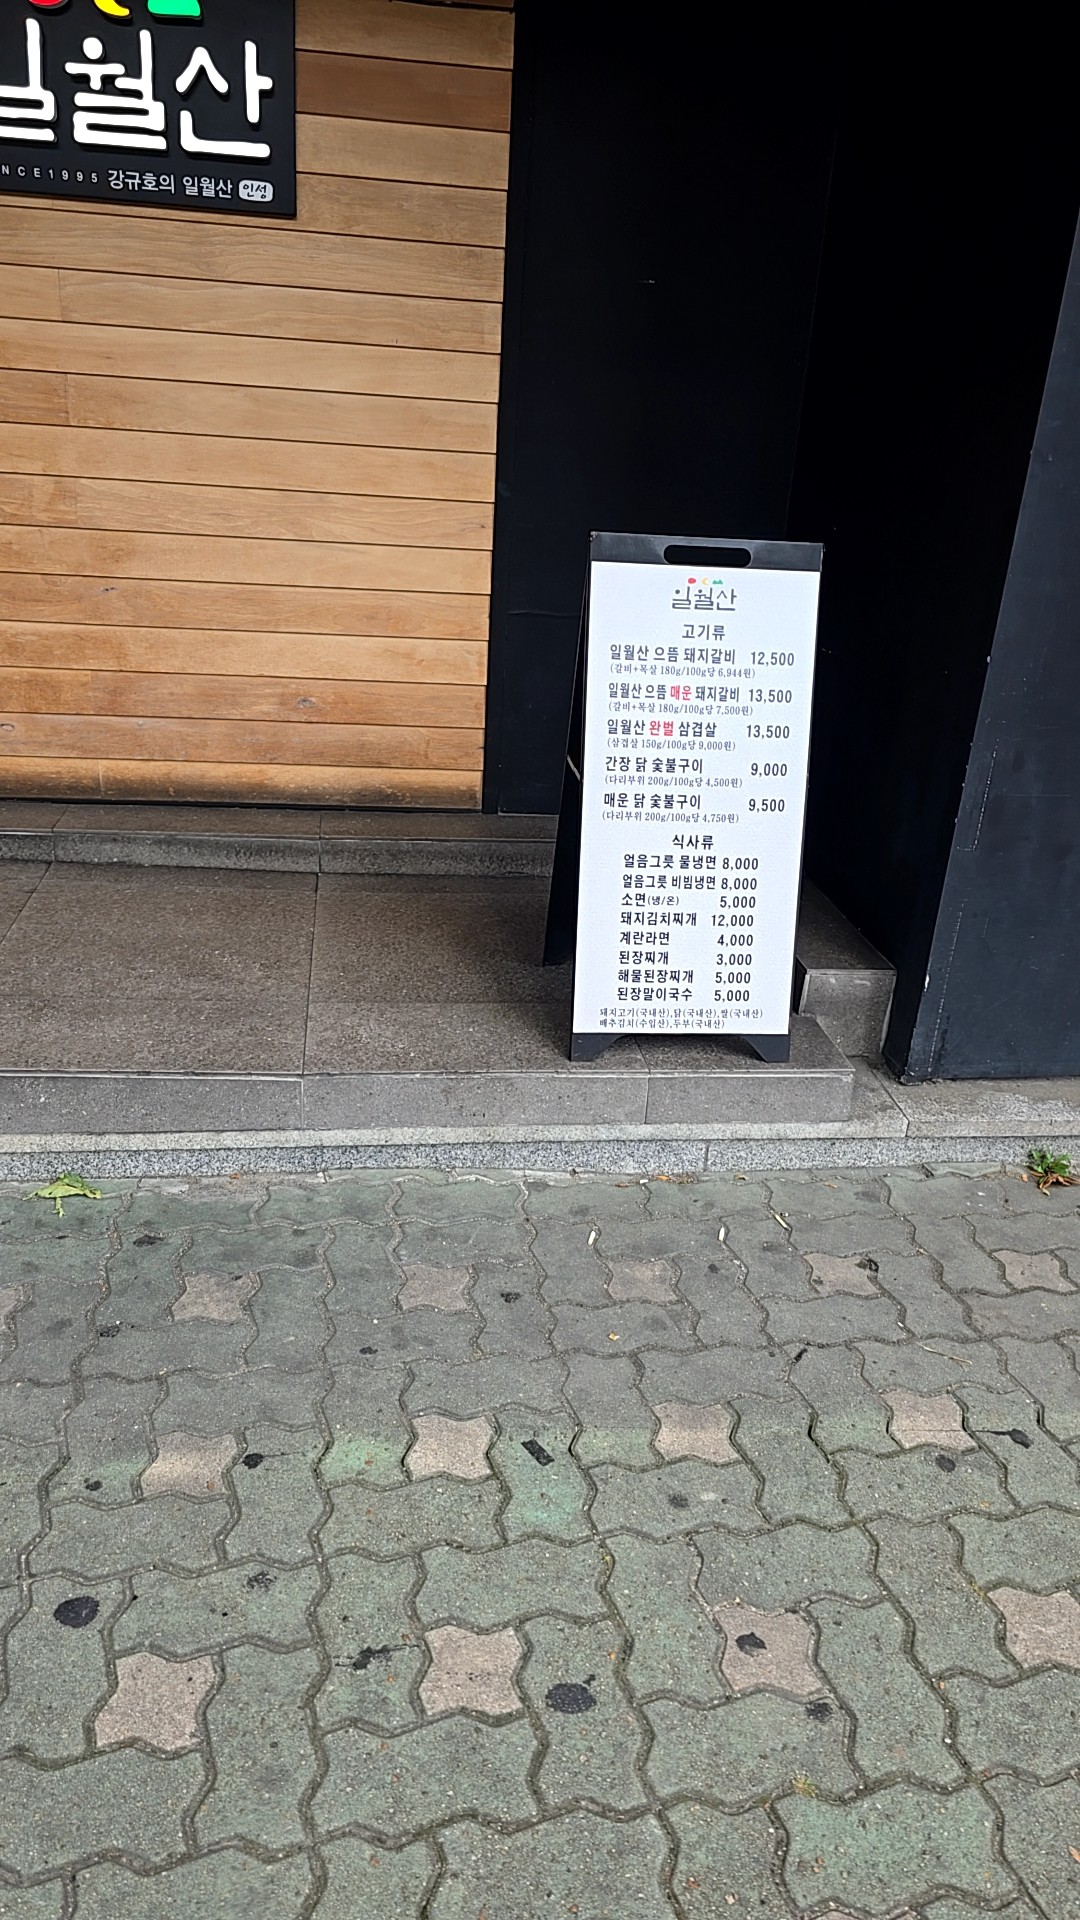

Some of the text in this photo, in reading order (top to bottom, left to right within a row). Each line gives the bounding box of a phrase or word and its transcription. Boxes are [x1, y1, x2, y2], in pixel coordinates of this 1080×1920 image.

[107, 170, 175, 194] 강규호의
[182, 176, 233, 199] 일월산
[242, 183, 268, 200] 인성
[671, 585, 738, 612] 일월산
[681, 624, 726, 641] 고기류
[609, 644, 795, 667] 일월산 으뜸 돼지갈비 12,500
[608, 682, 793, 704] 일월산 으뜸 매운 돼지갈비 13,500
[607, 718, 646, 736] 일월산
[678, 721, 717, 738] 삼겹살
[746, 724, 790, 740] 13,500
[605, 755, 788, 778] 간장 닭 숯불구이 9,000
[604, 792, 786, 813] 매운 닭 숯불구이 9,500
[672, 834, 714, 851] 식사류
[624, 853, 759, 871] 얼음그릇 물냉면 8,000
[622, 873, 758, 891] 얼음그릇 비빔냉면 8,000
[719, 896, 756, 910] 5,000
[620, 911, 754, 927] 돼지김치찌개 12,000
[619, 931, 754, 947] 계란라면 4,000
[618, 950, 752, 967] 된장찌개 3,000
[617, 969, 751, 985] 해물된장찌개 5,000
[616, 987, 750, 1003] 된장말이국수 5,000
